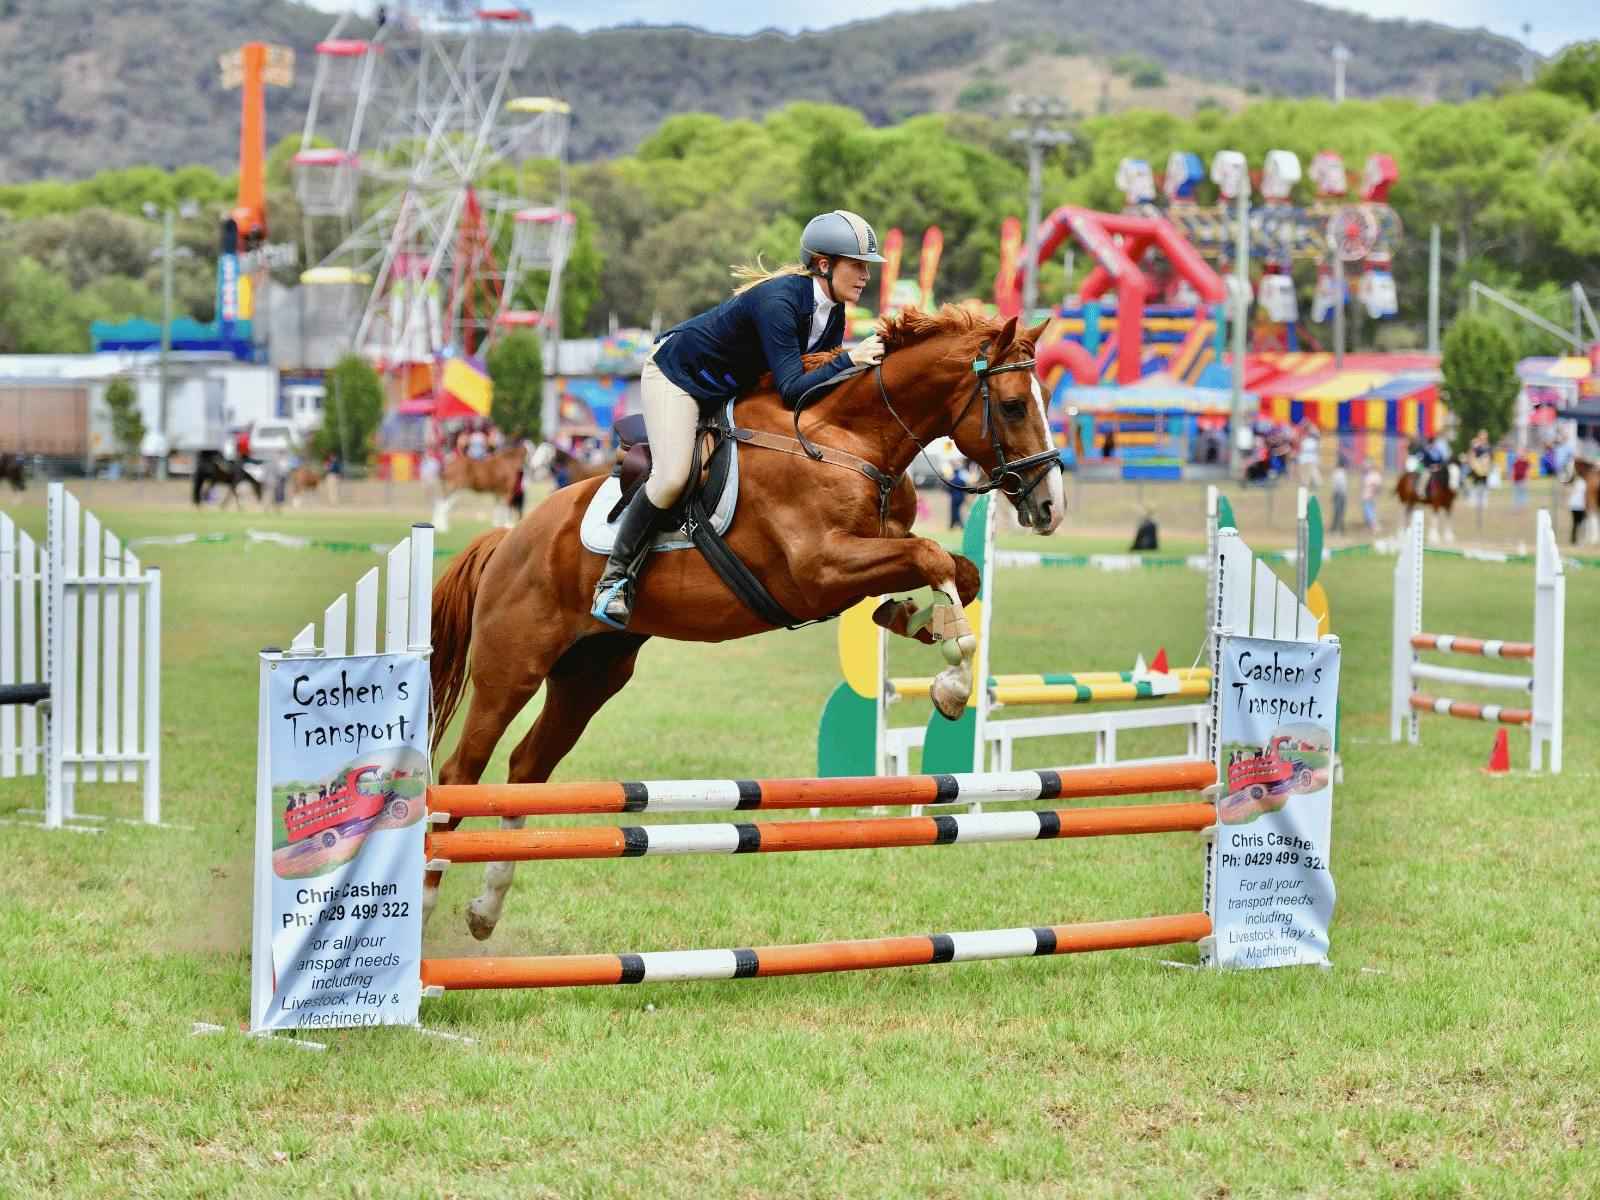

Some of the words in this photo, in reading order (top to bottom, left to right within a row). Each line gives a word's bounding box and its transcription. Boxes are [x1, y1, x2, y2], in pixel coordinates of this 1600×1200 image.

[1238, 651, 1322, 684] Cashen's
[292, 664, 409, 708] Cashen's
[1231, 682, 1323, 725] Transport.
[283, 712, 415, 754] Transport.
[1232, 833, 1264, 848] Chris
[1222, 854, 1241, 868] Ph:
[1244, 852, 1273, 867] 0429
[1275, 851, 1299, 865] 499
[1304, 856, 1325, 870] 32
[296, 886, 340, 905] Chris
[342, 881, 397, 898] Cashen
[1240, 880, 1258, 892] For
[1260, 878, 1273, 890] all
[1275, 879, 1304, 892] your
[1228, 895, 1274, 911] transport
[1276, 894, 1316, 906] needs
[283, 912, 313, 928] Ph:
[319, 904, 345, 921] 029
[351, 903, 378, 920] 499
[382, 901, 409, 918] 322
[1245, 911, 1293, 925] including
[310, 938, 329, 951] or
[333, 936, 352, 950] all
[352, 936, 387, 952] your
[1229, 929, 1278, 944] Livestock,
[1280, 927, 1306, 941] Hay
[1308, 929, 1316, 939] &
[1246, 945, 1298, 959] Machinery
[297, 954, 351, 973] ansport
[354, 953, 400, 967] needs
[311, 973, 373, 989] including
[281, 992, 349, 1010] Livestock,
[355, 991, 387, 1007] Hay
[391, 993, 400, 1005] &
[298, 1011, 377, 1026] Machinery
